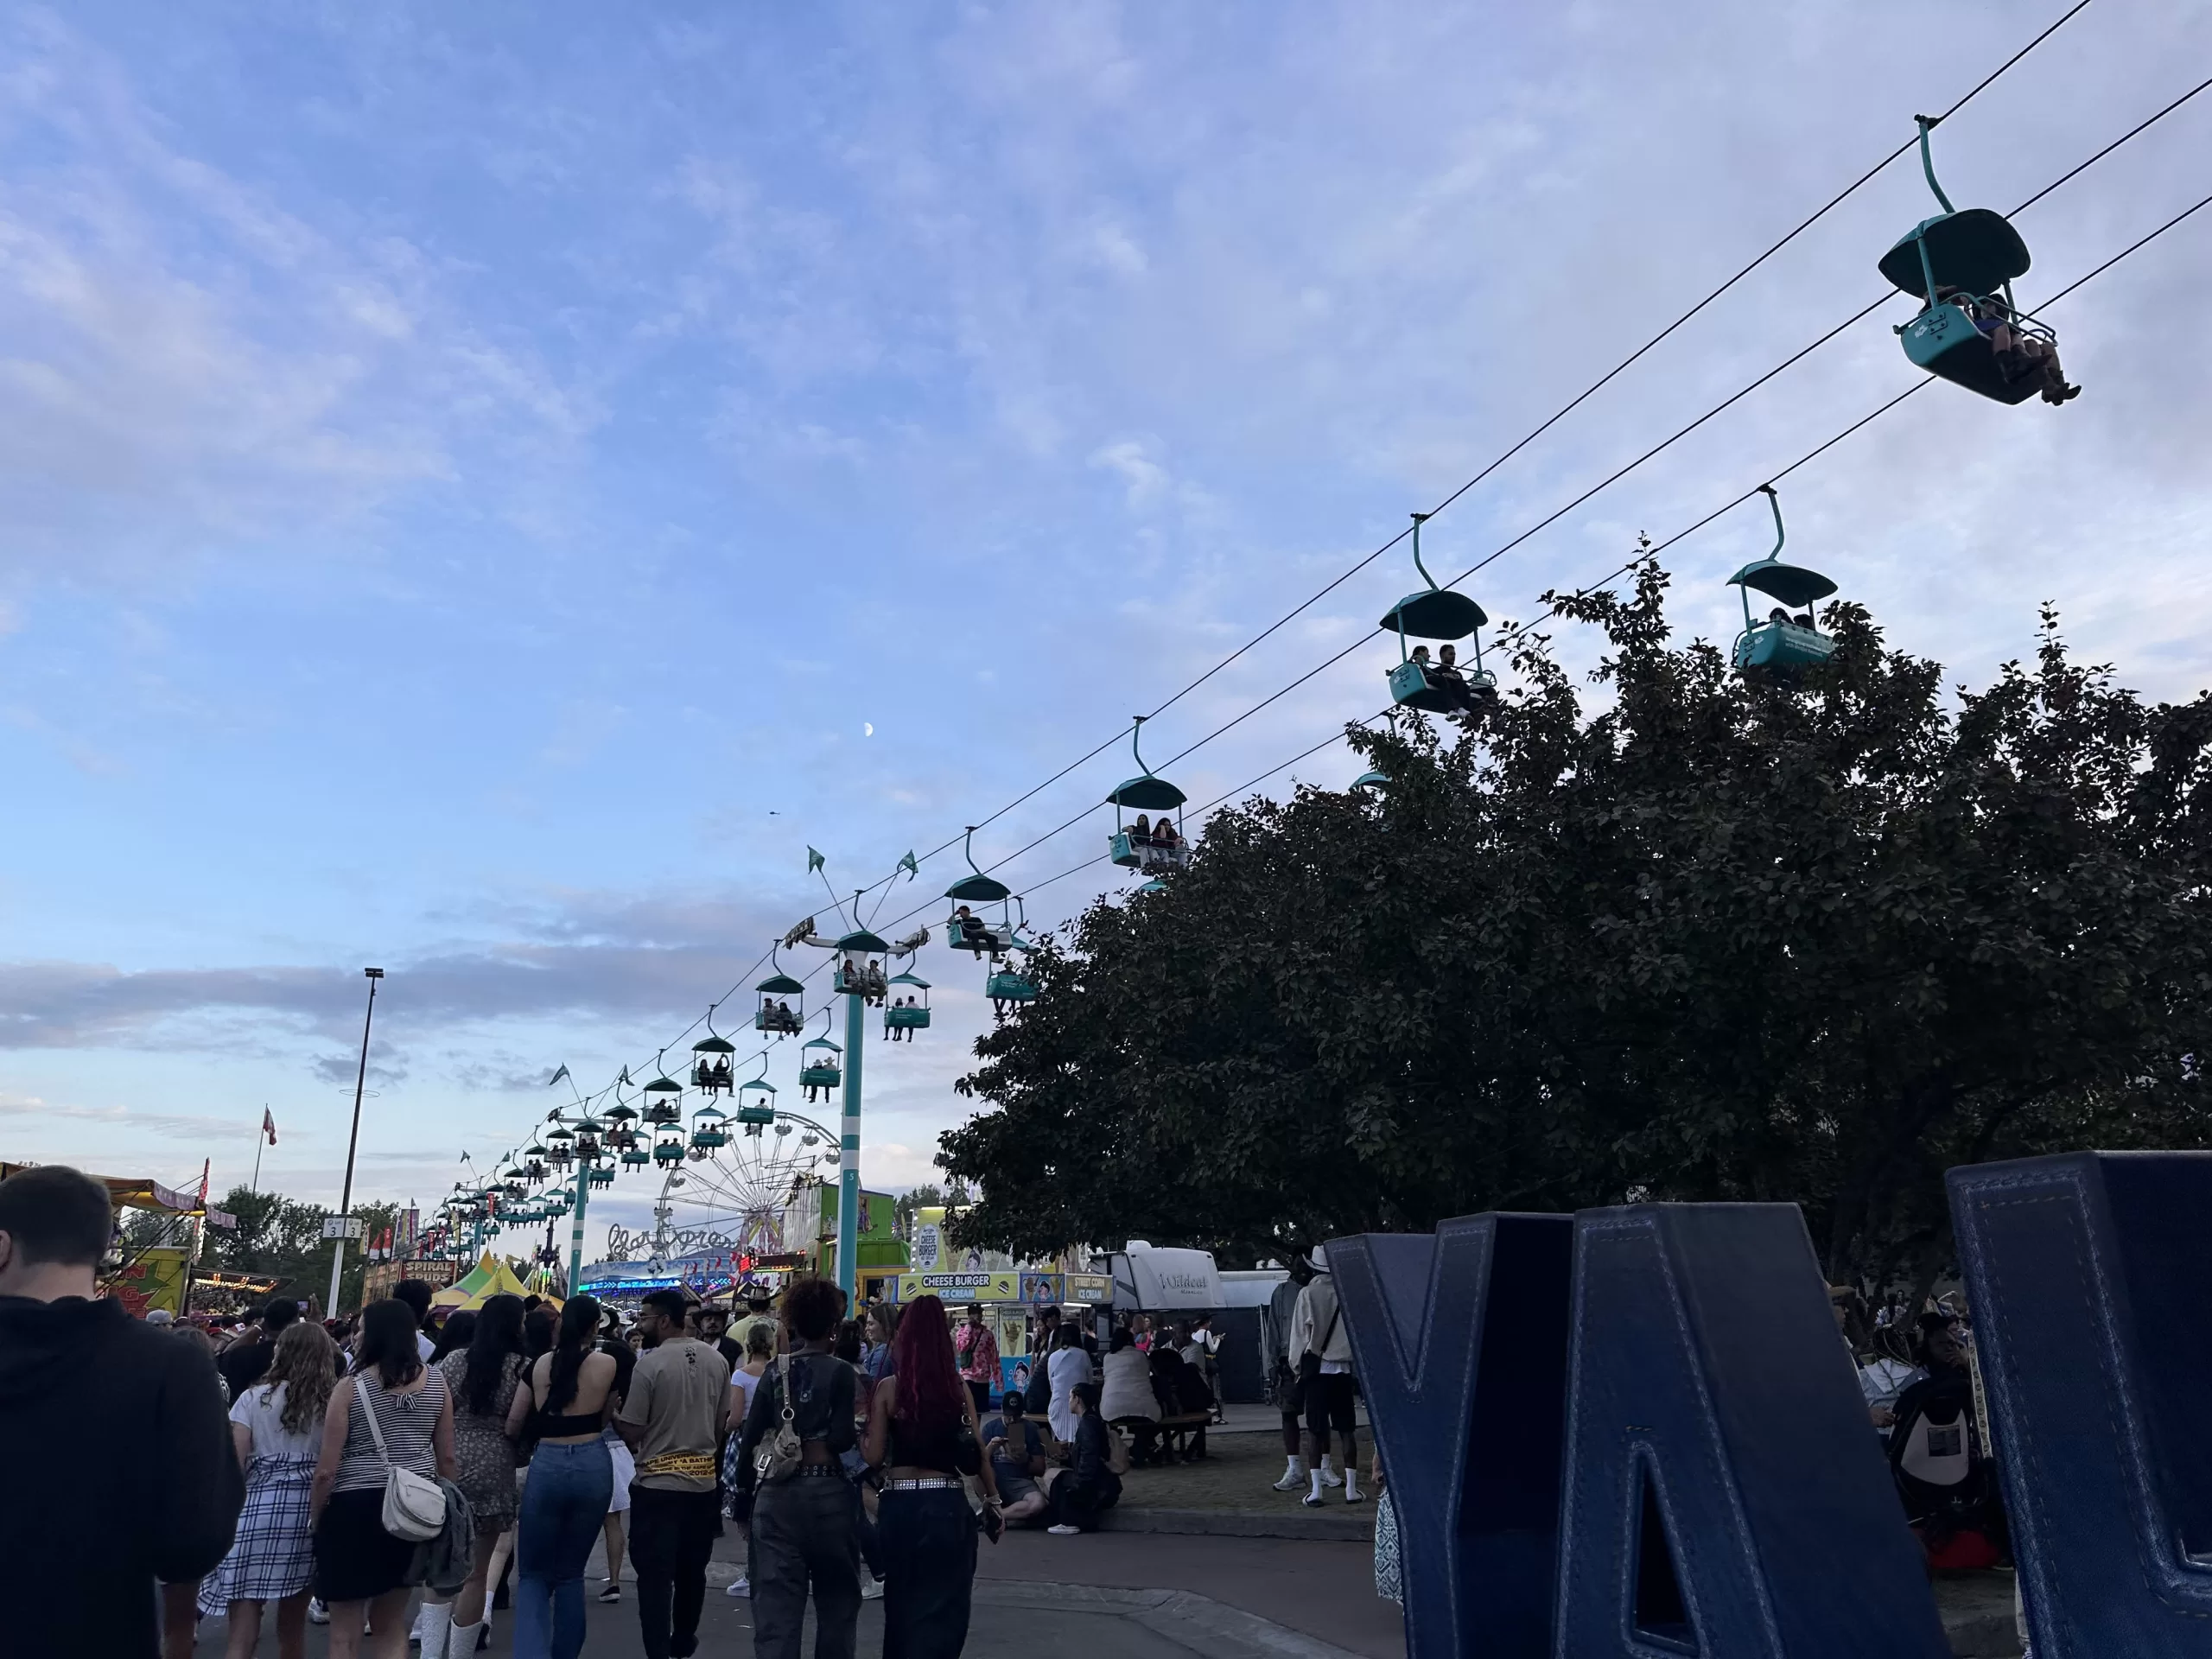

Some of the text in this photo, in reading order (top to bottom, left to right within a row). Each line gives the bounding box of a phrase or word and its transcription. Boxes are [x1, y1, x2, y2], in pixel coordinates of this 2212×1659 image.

[330, 1227, 336, 1236] 3
[350, 1227, 356, 1236] 3
[405, 1261, 451, 1271] SPIRAL
[406, 1273, 449, 1282] SPUDS
[922, 1274, 990, 1287] CHEESE BURGER
[1159, 1272, 1208, 1289] Wildcat
[938, 1287, 976, 1299] ICE CREAM
[1086, 1289, 1103, 1300] CREAM
